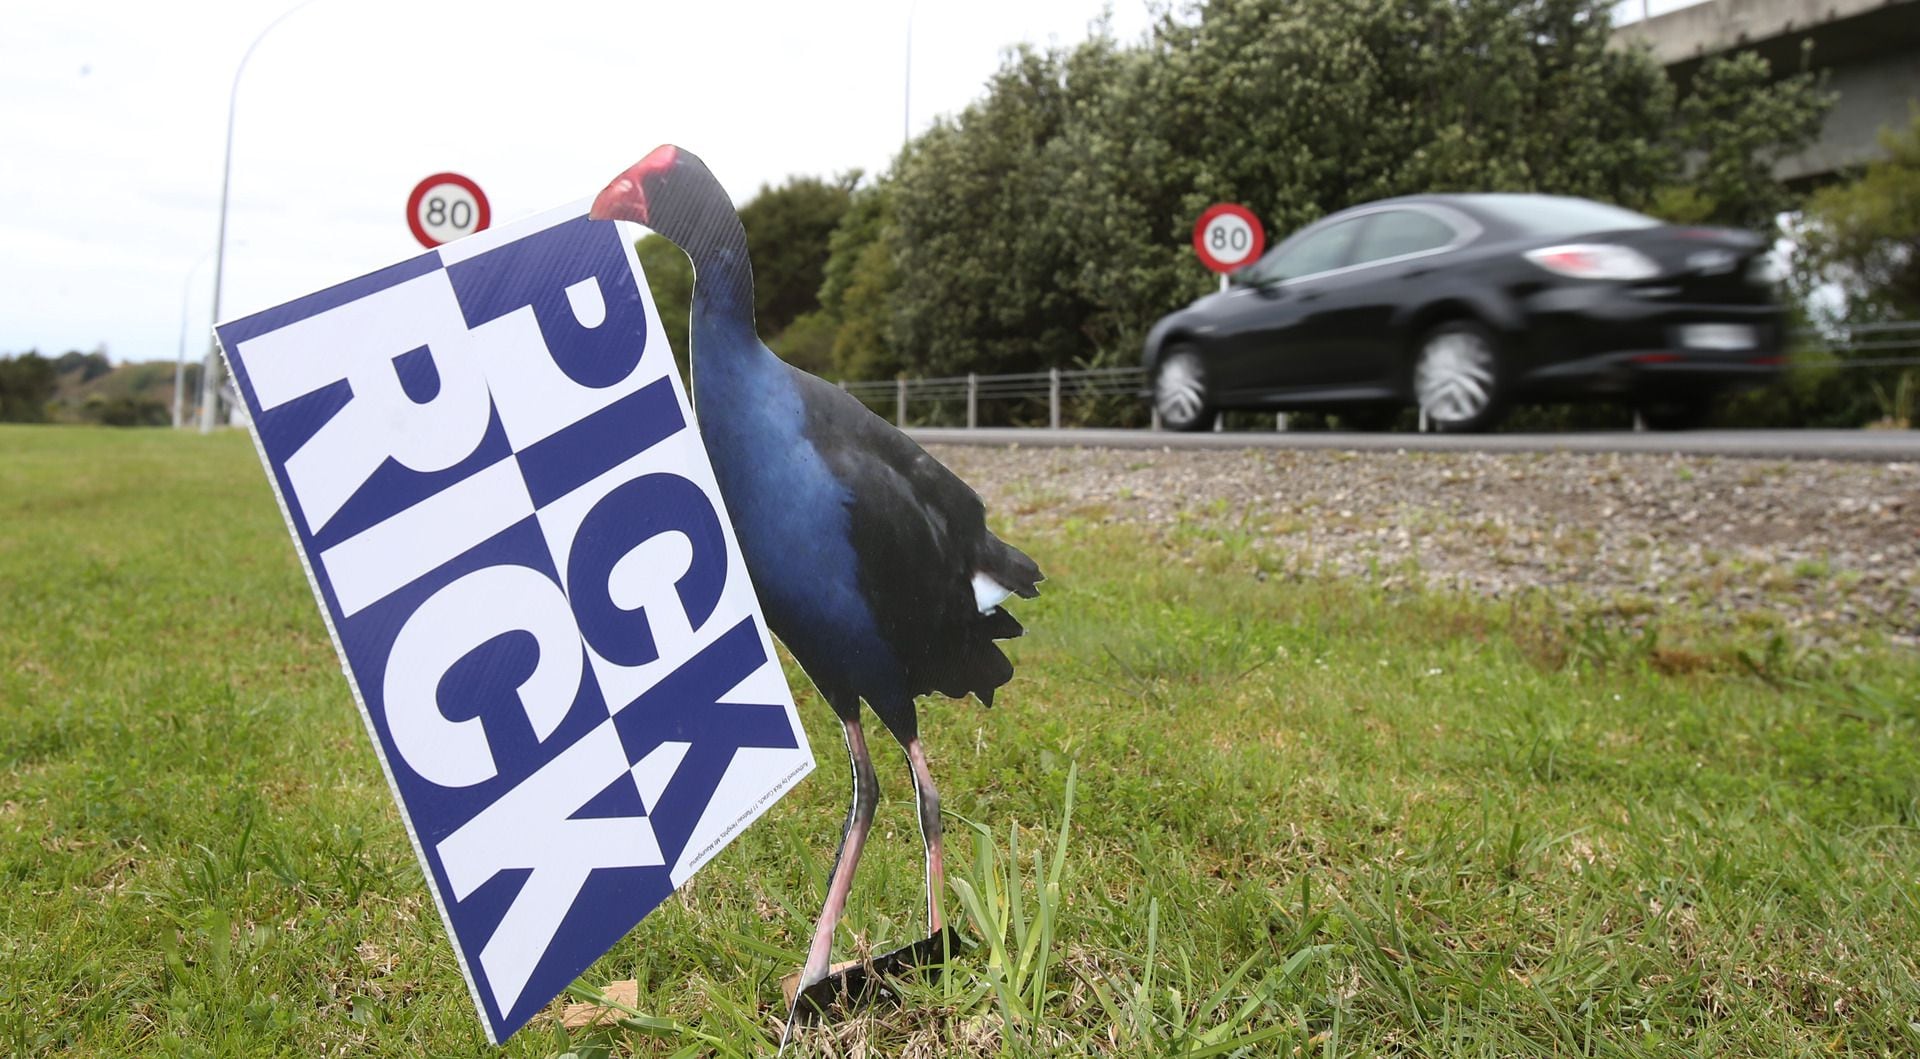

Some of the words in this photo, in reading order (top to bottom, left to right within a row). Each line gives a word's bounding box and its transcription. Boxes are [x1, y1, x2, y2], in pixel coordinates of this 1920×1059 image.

[426, 197, 471, 229] 80
[1212, 226, 1247, 250] 80
[236, 268, 666, 1021] RICK
[445, 217, 799, 876] PICK
